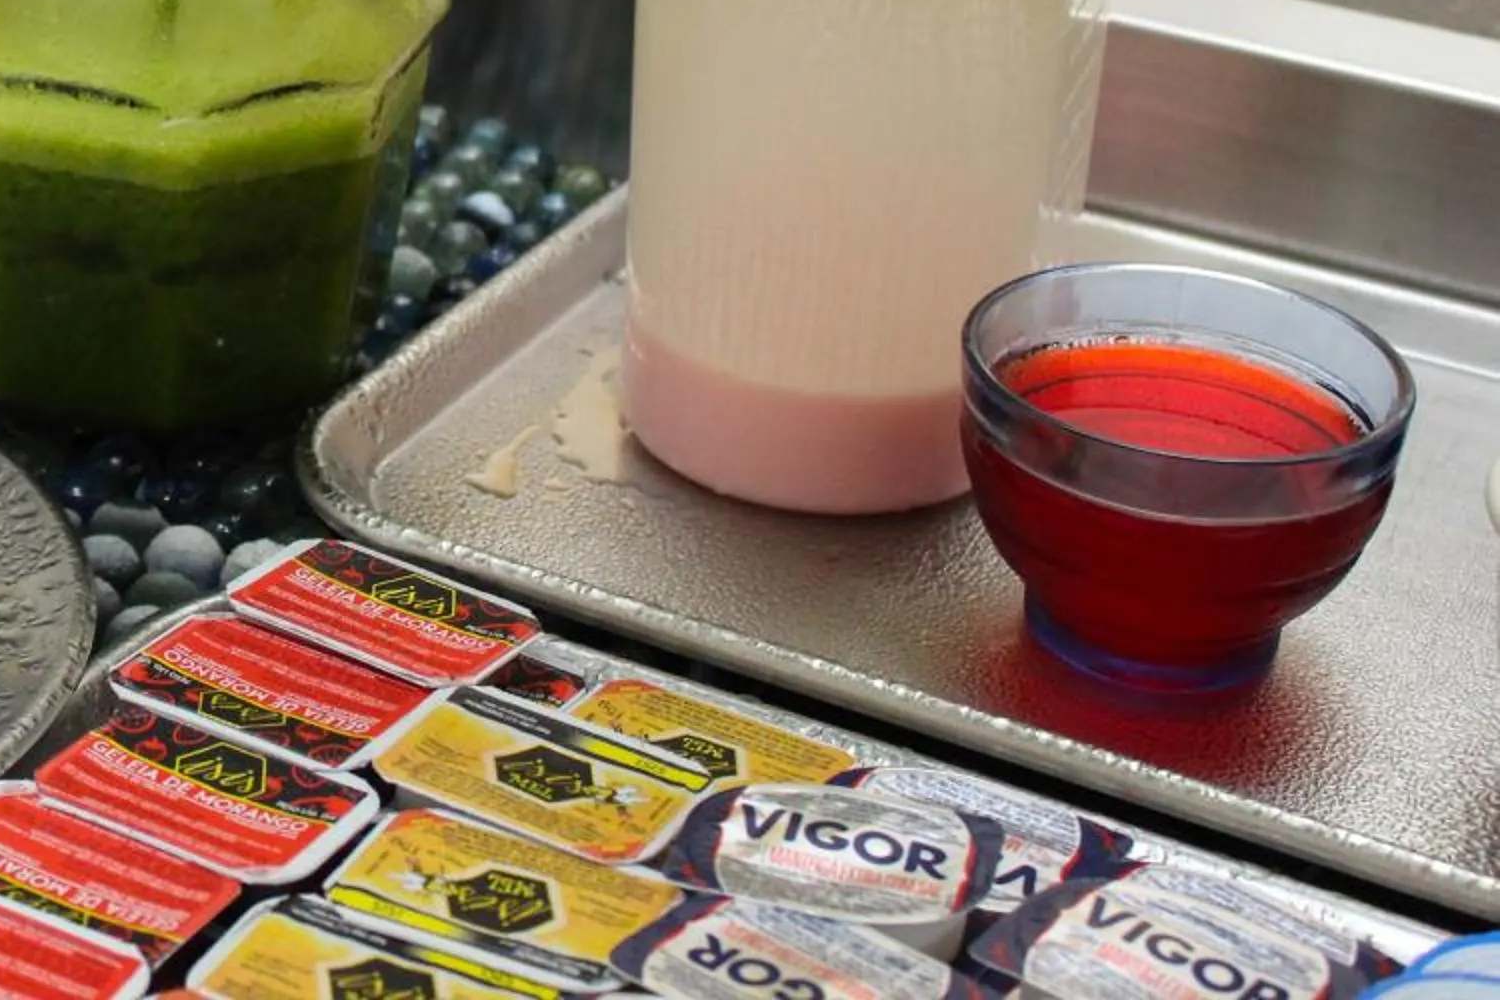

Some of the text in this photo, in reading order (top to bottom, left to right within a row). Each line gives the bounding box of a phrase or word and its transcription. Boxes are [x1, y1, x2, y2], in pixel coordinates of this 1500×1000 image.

[293, 567, 357, 605] GELEIA
[360, 600, 387, 617] DE
[388, 611, 497, 650] MORANGO
[163, 648, 269, 701] MORANGO
[272, 695, 300, 713] DE
[302, 705, 372, 734] GELEIA
[92, 739, 160, 782] GELEIA
[161, 775, 192, 796] DE
[193, 790, 311, 833] MORANGO
[739, 802, 949, 881] VIGOR
[72, 889, 104, 909] DE
[105, 900, 179, 932] GELEIA
[687, 933, 826, 1000] GOR
